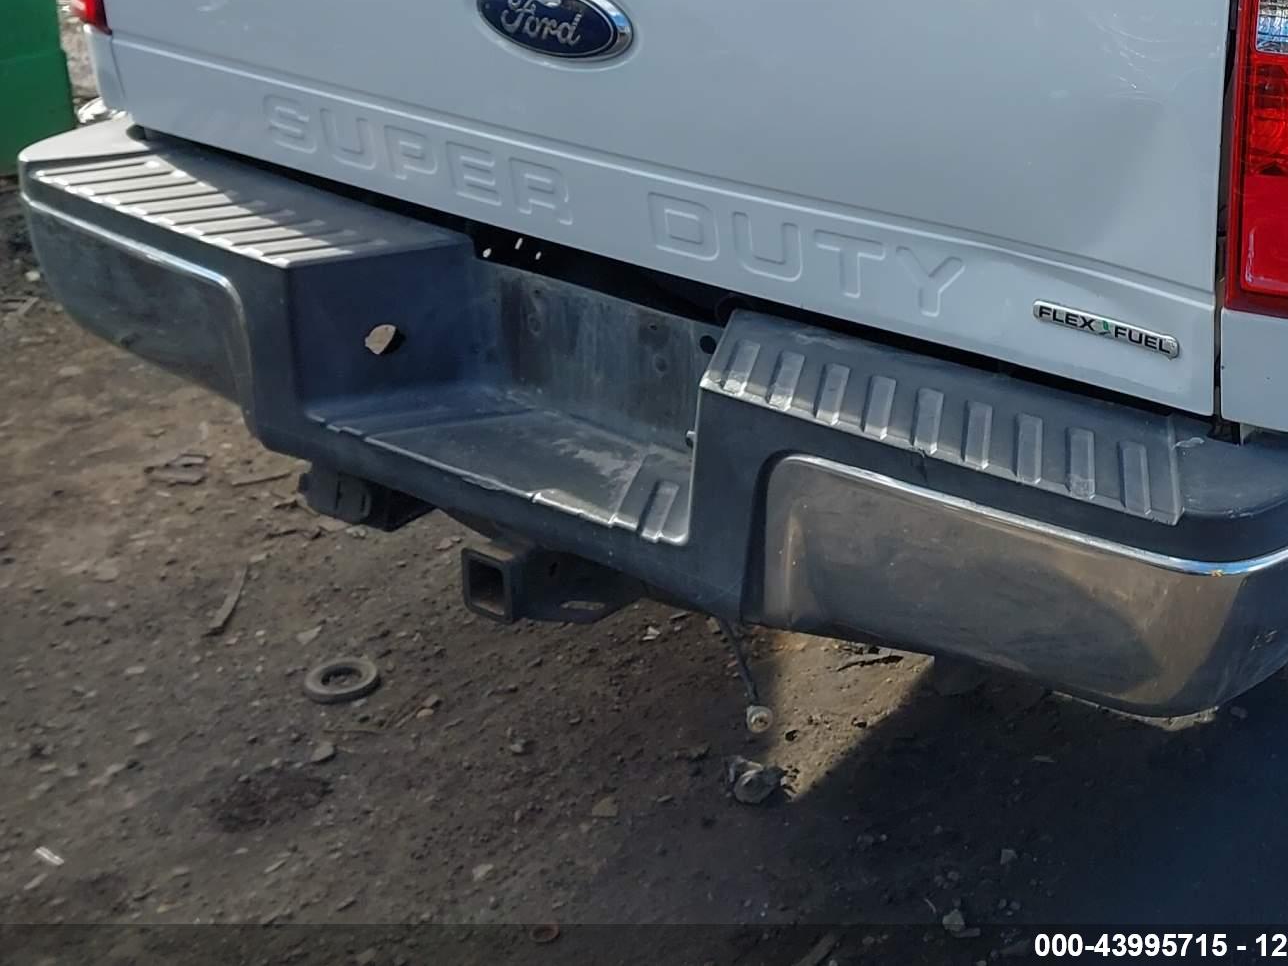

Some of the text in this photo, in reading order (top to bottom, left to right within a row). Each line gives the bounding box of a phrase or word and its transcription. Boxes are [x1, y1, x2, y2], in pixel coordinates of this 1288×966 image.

[261, 92, 966, 318] SUPER DUTY
[1038, 305, 1171, 354] FLEX FUEL
